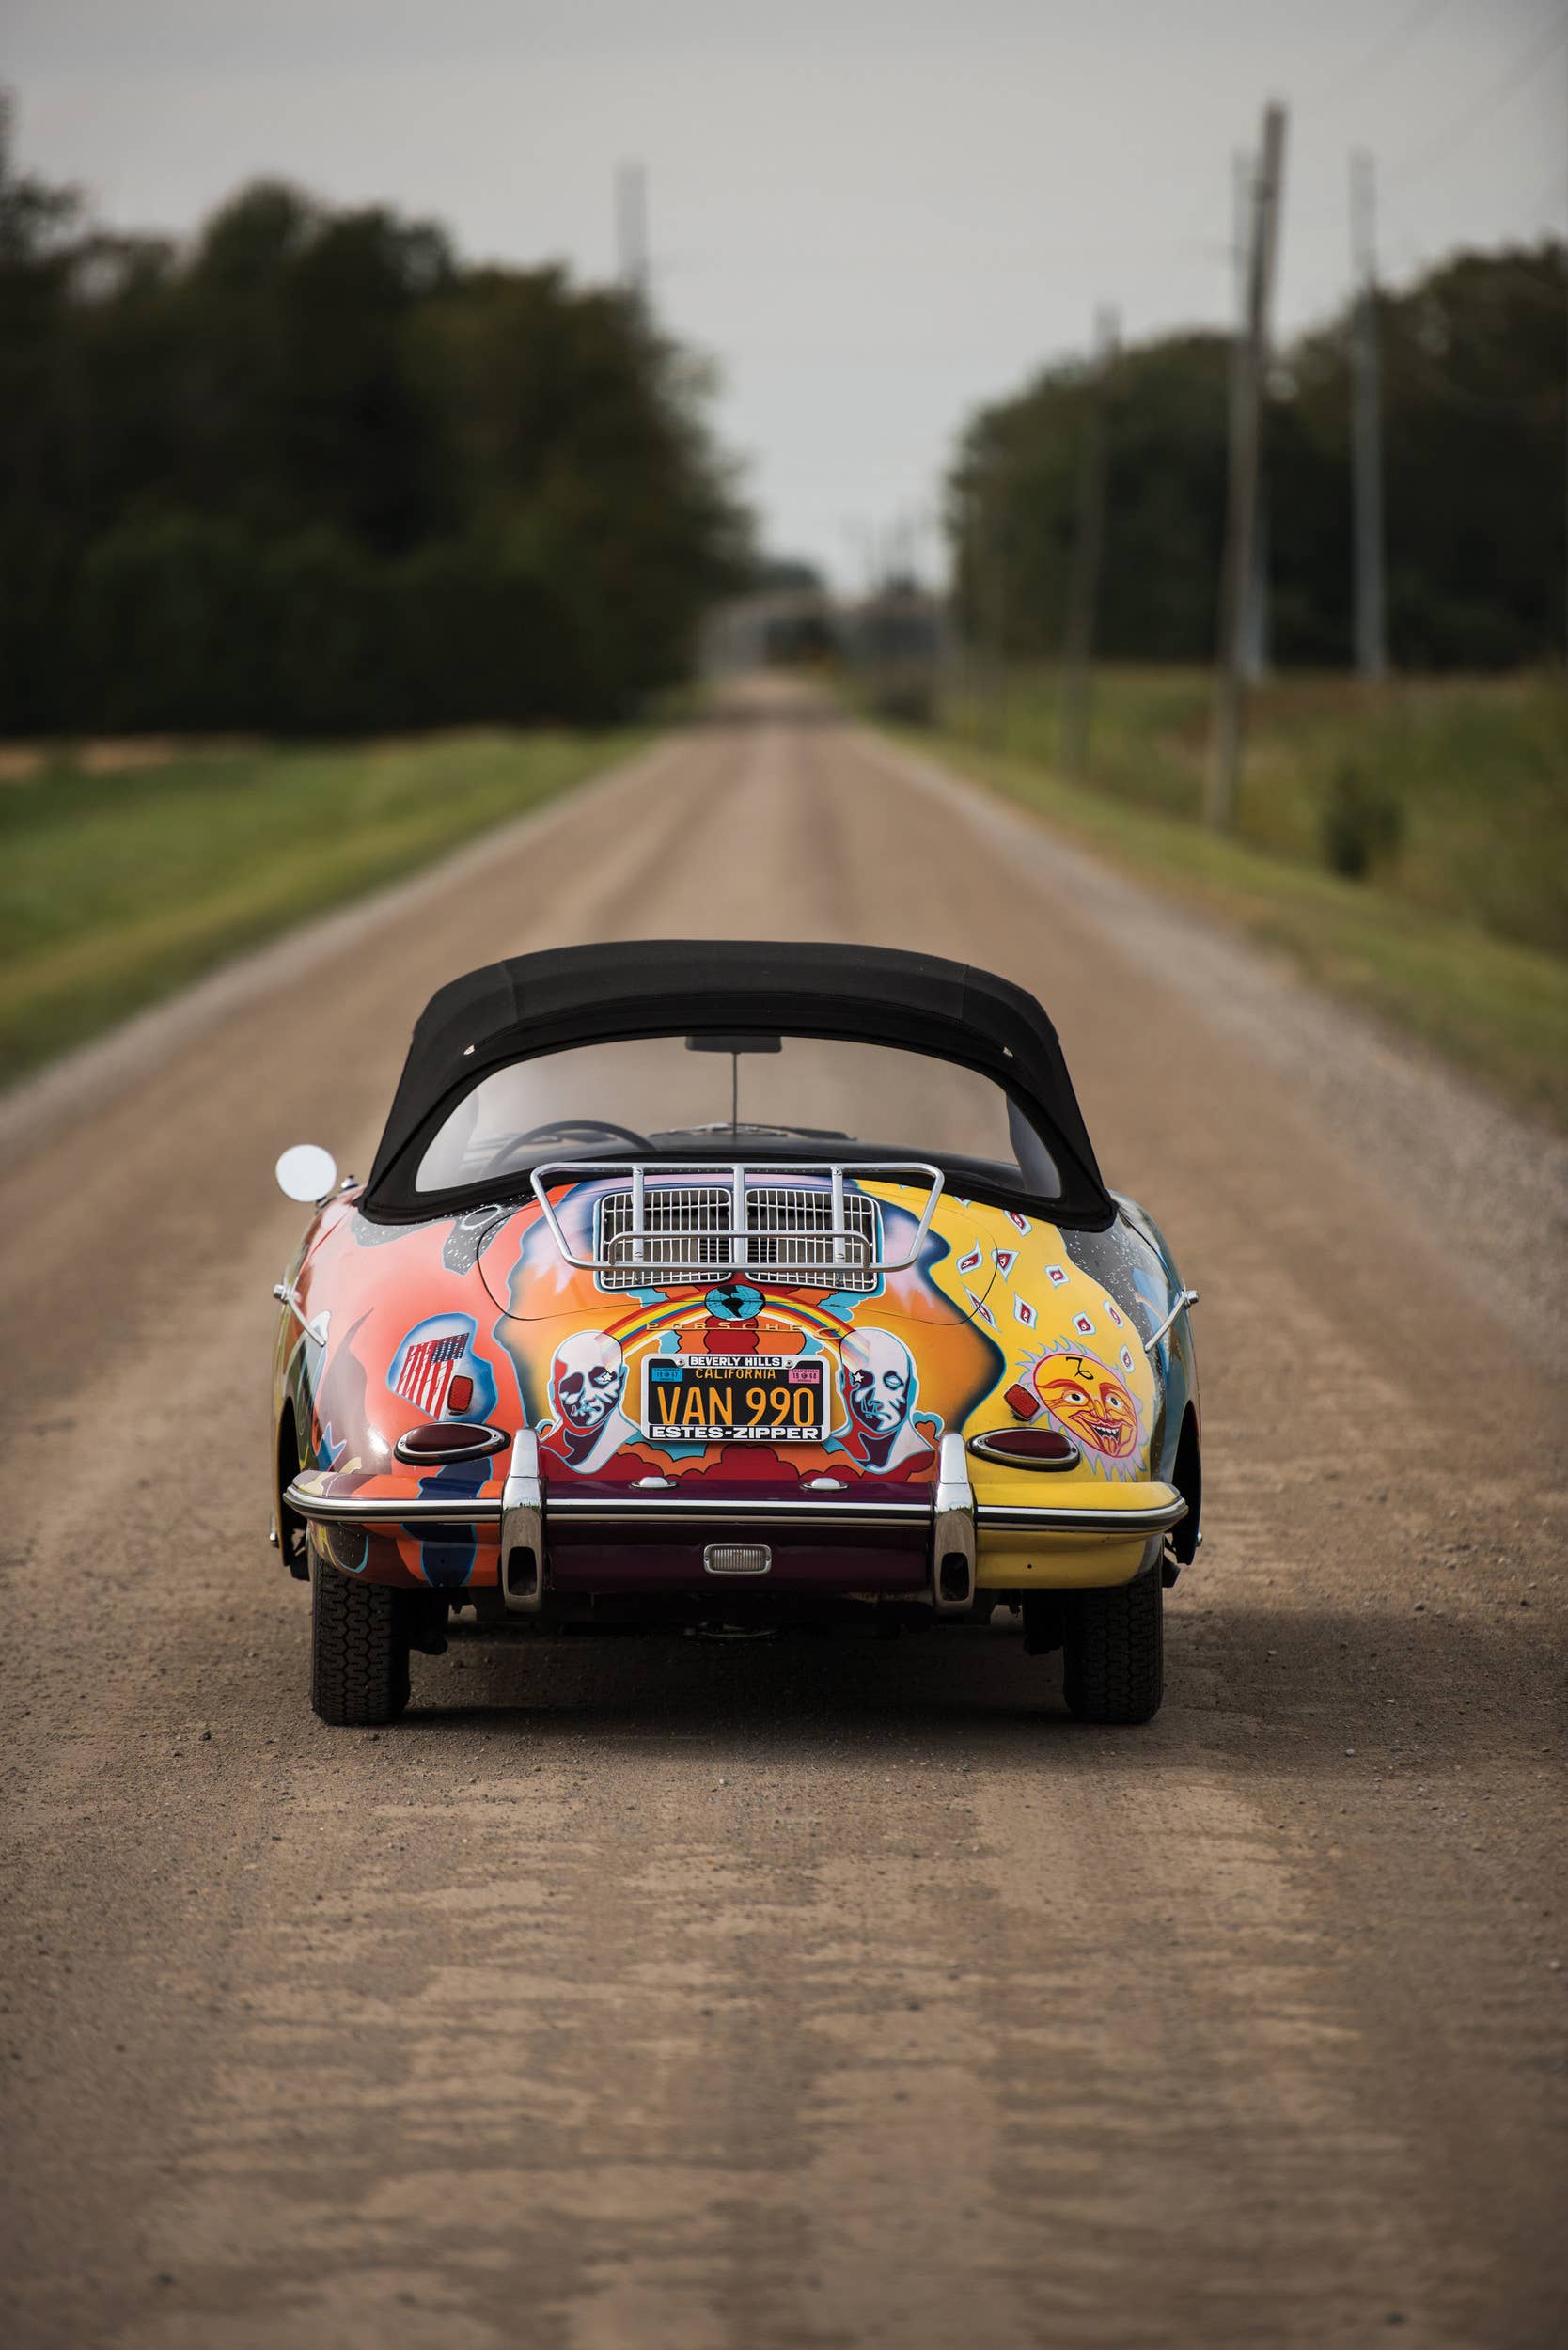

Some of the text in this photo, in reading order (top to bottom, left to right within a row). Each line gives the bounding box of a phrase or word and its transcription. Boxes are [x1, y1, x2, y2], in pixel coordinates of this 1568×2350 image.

[646, 1322, 804, 1332] PORSCHE
[690, 1356, 781, 1367] BEVERLY HILLS
[695, 1368, 776, 1379] CALIFORNIA
[656, 1386, 815, 1427] VAN 990
[652, 1426, 819, 1440] ESTES-ZIPPER
